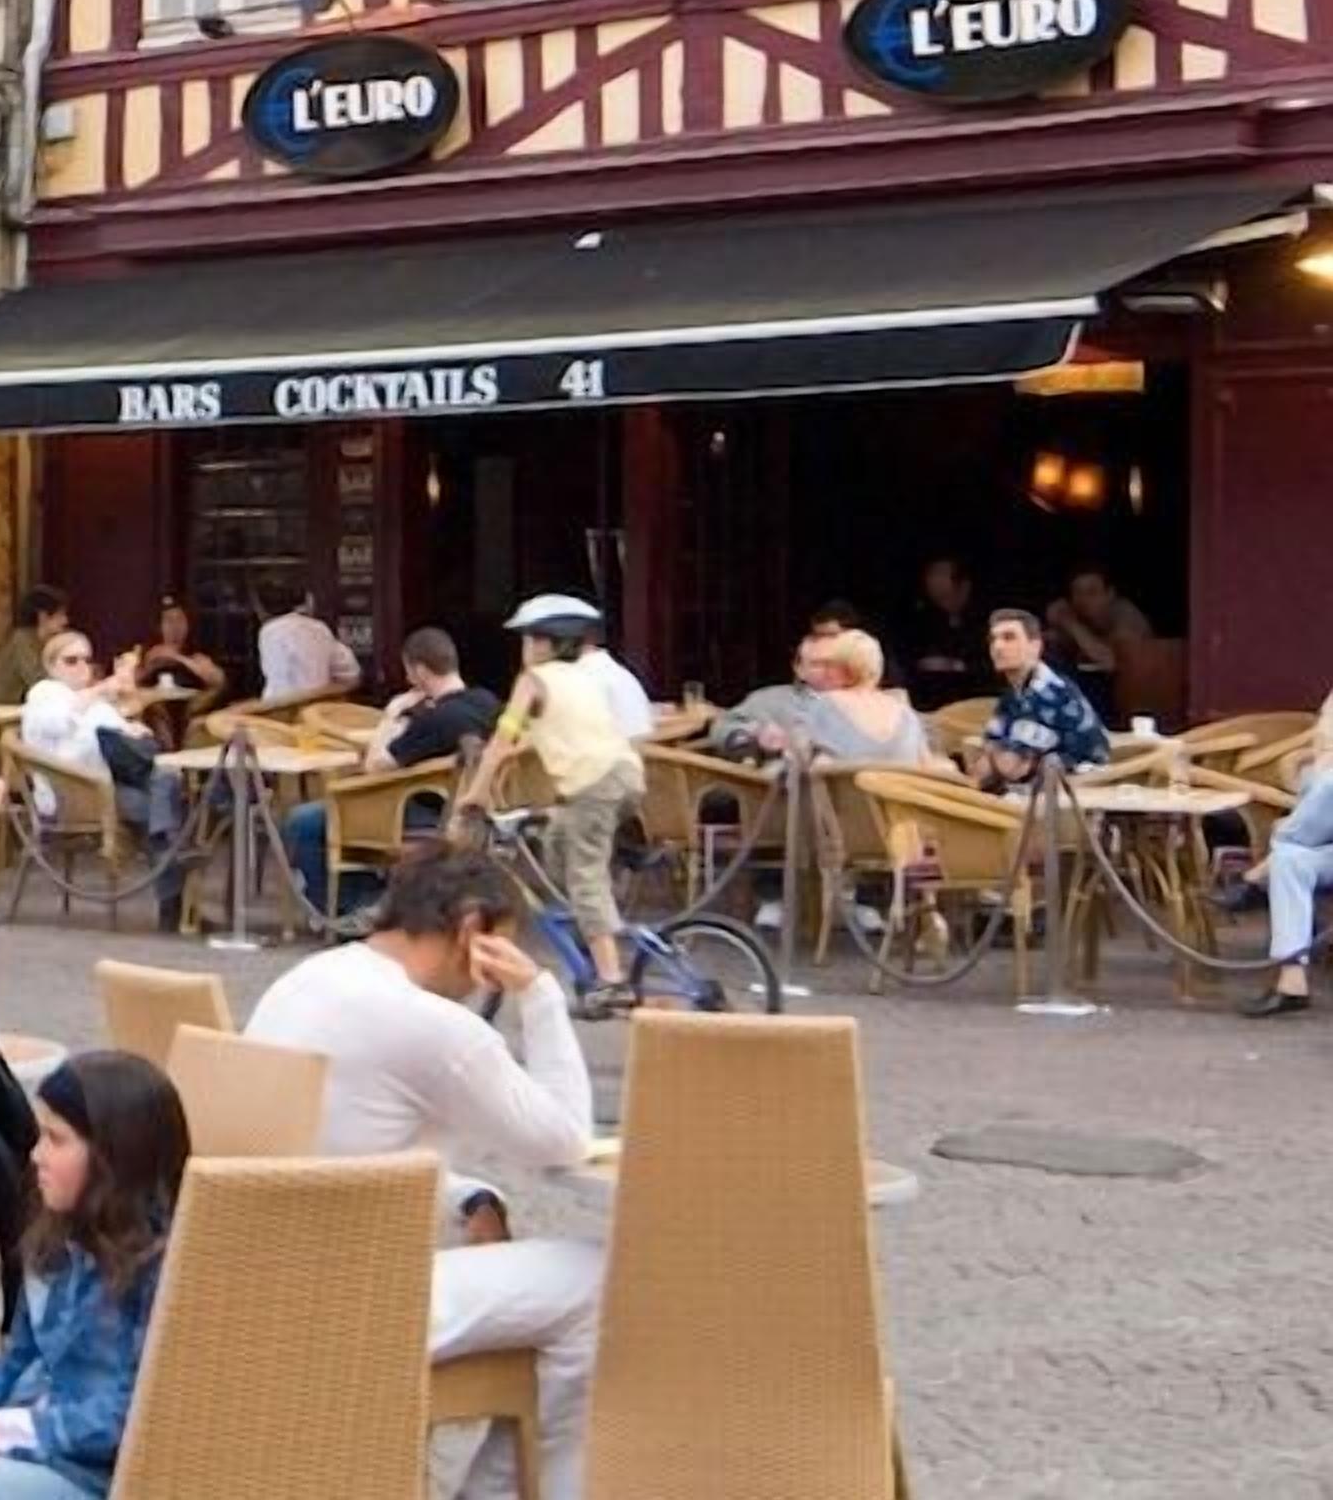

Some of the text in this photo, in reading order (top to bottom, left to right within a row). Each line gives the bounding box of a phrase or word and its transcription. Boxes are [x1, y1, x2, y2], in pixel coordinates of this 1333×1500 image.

[293, 75, 437, 132] L'EURO
[118, 360, 605, 422] BARS COCKTAILS 41
